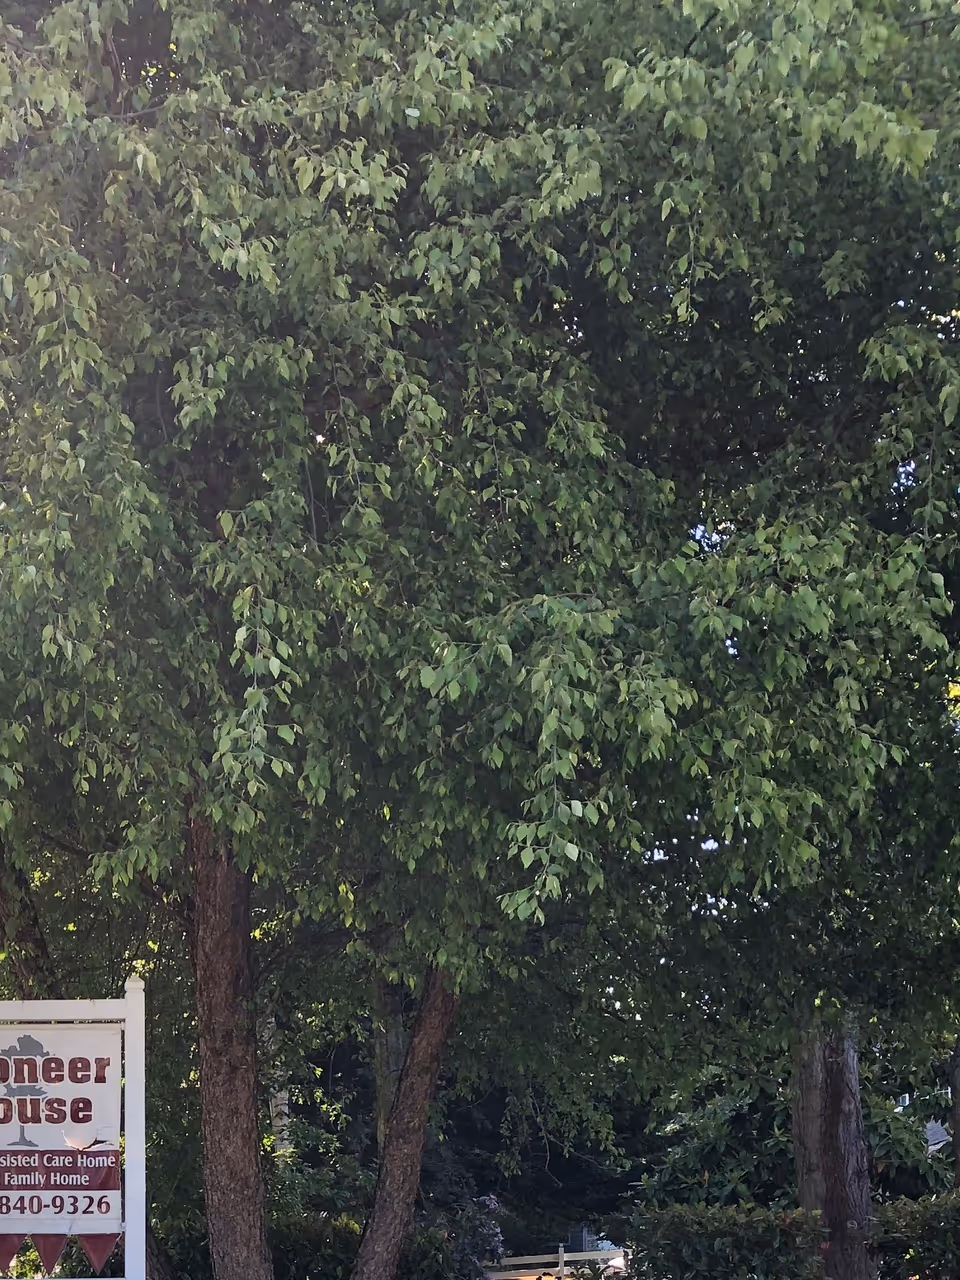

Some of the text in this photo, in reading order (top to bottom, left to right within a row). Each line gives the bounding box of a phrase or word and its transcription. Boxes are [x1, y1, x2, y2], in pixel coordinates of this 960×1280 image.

[43, 1154, 73, 1167] Care
[77, 1154, 116, 1168] Home
[4, 1171, 47, 1188] Family
[50, 1172, 90, 1186] Home
